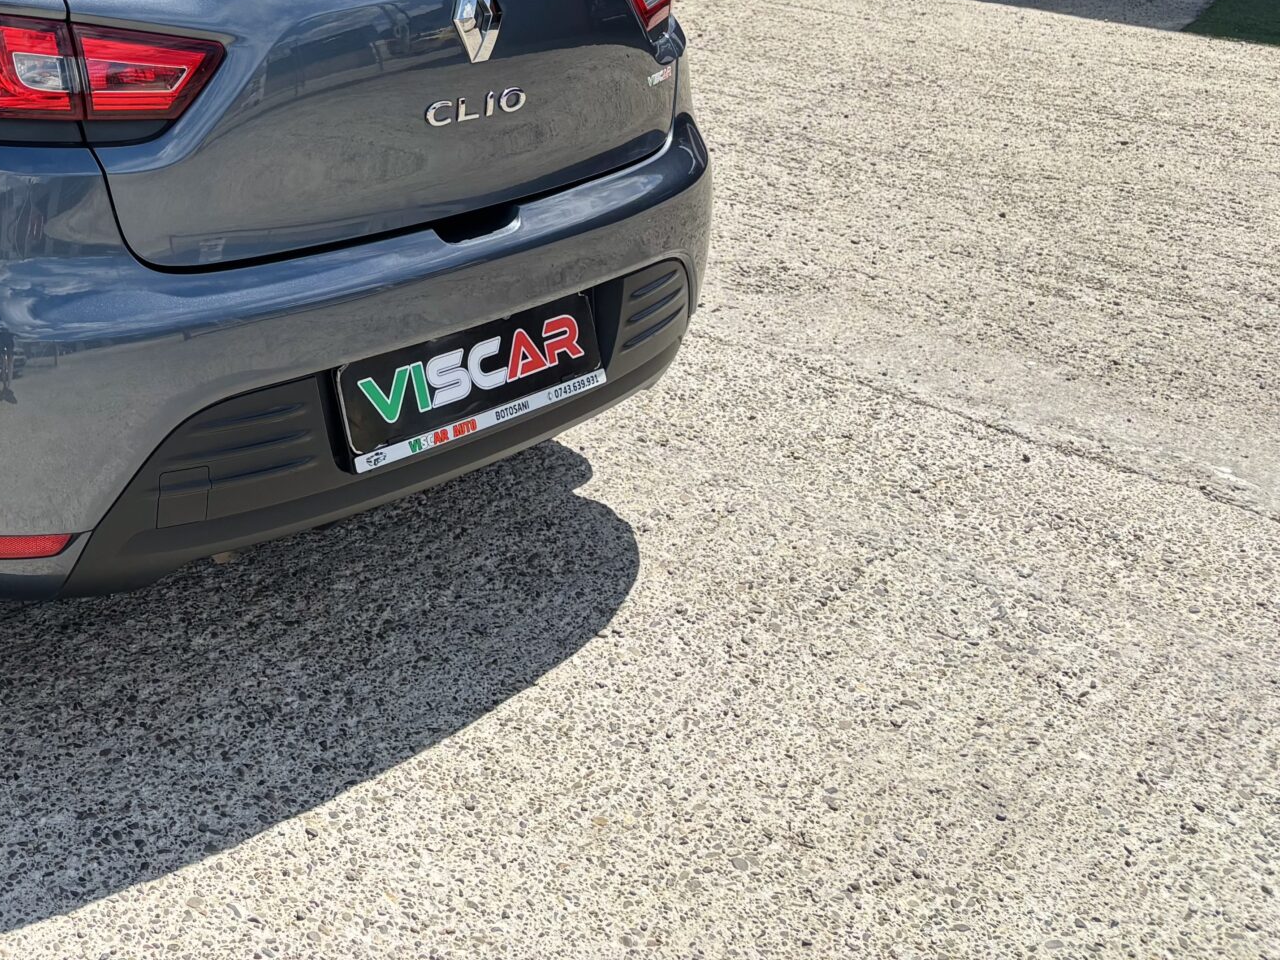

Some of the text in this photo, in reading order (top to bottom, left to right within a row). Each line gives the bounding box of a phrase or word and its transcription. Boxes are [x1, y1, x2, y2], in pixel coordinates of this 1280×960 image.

[425, 86, 527, 127] CLIO
[357, 314, 585, 424] VISCAR
[408, 374, 599, 453] VISCAR AUTO BOTOSANI 0743.639.931
